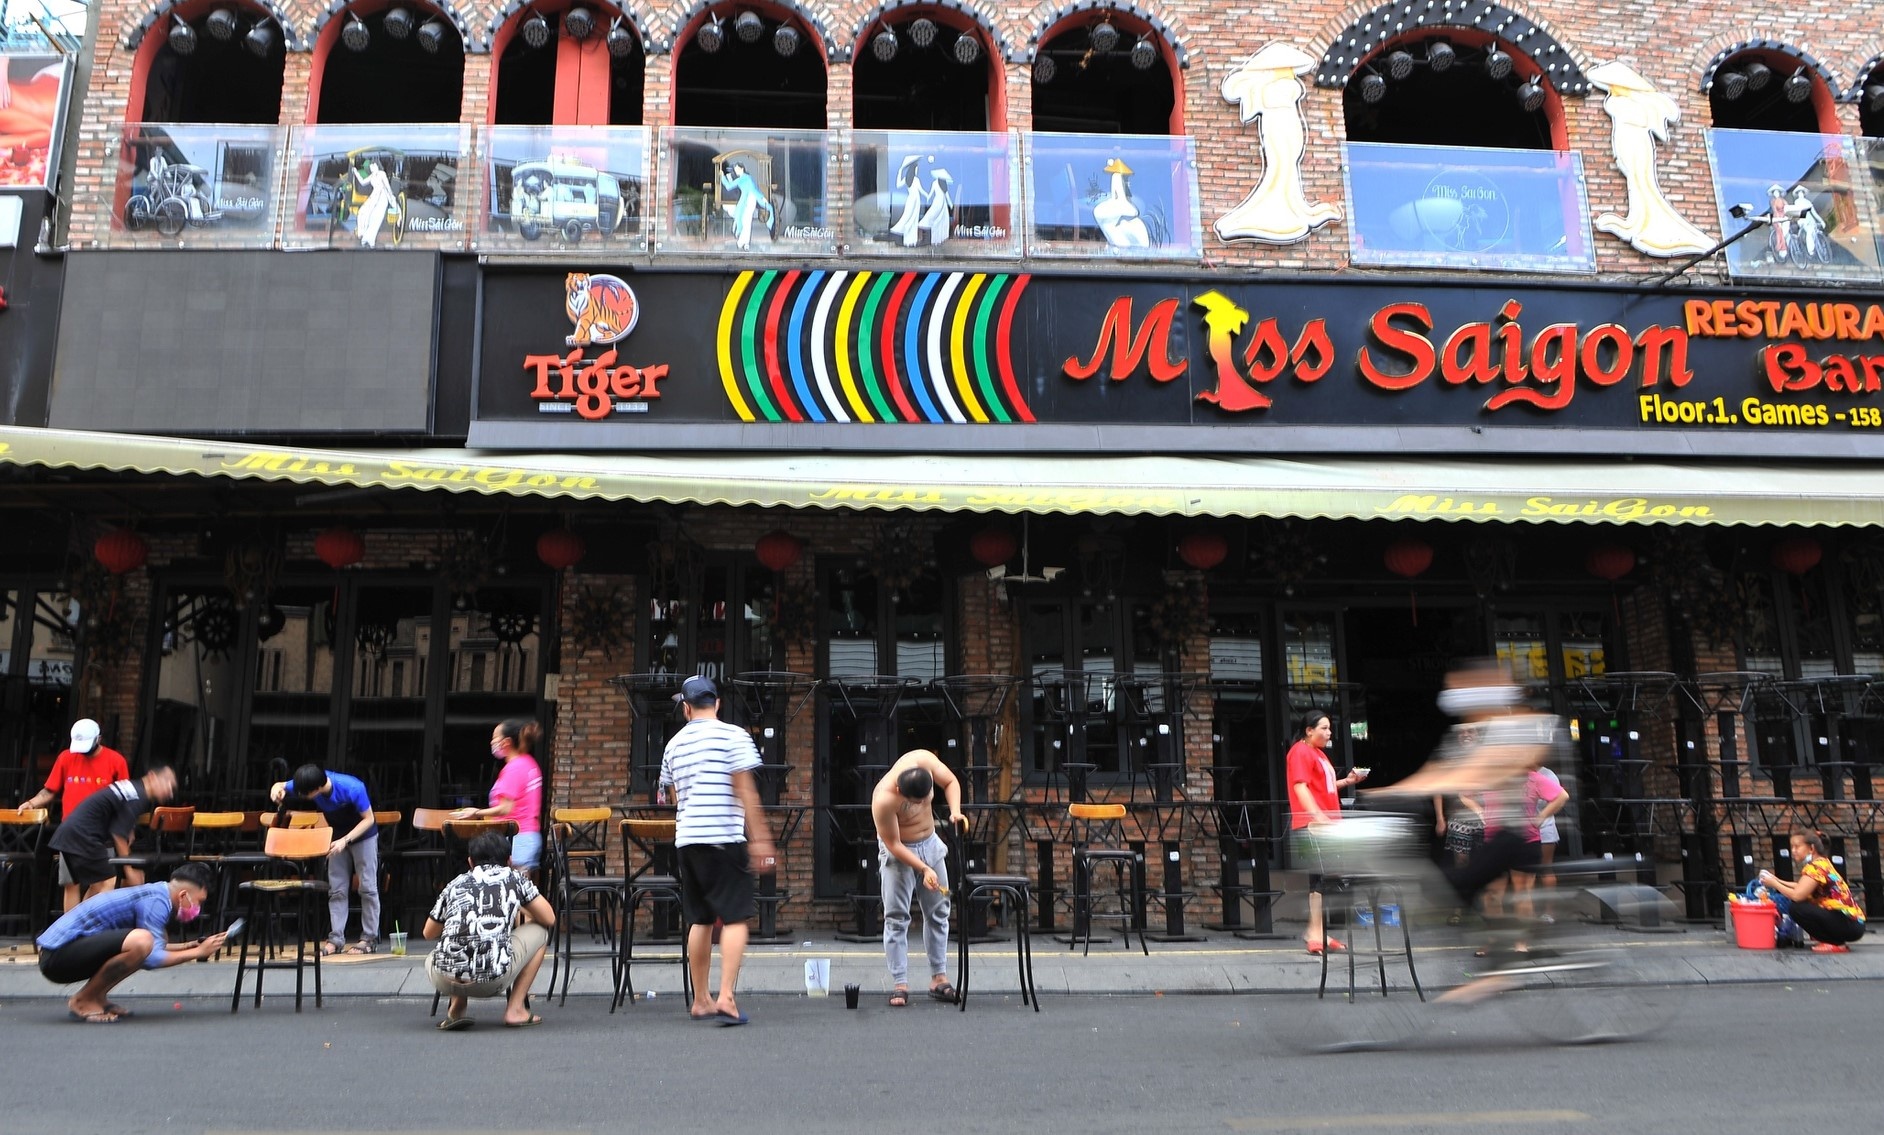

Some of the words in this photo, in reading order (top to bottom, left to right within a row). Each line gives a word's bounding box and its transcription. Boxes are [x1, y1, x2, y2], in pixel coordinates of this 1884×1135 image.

[1684, 299, 1884, 340] RESTAURA
[1355, 298, 1694, 411] Saigon
[1761, 342, 1884, 392] Bar
[523, 348, 669, 420] Tiger
[1741, 397, 1829, 426] Games
[1850, 407, 1882, 427] 158
[220, 452, 360, 476] Miss
[381, 460, 601, 490] SaiGon
[1374, 494, 1504, 514] Miss
[1521, 497, 1714, 519] SaiGon
